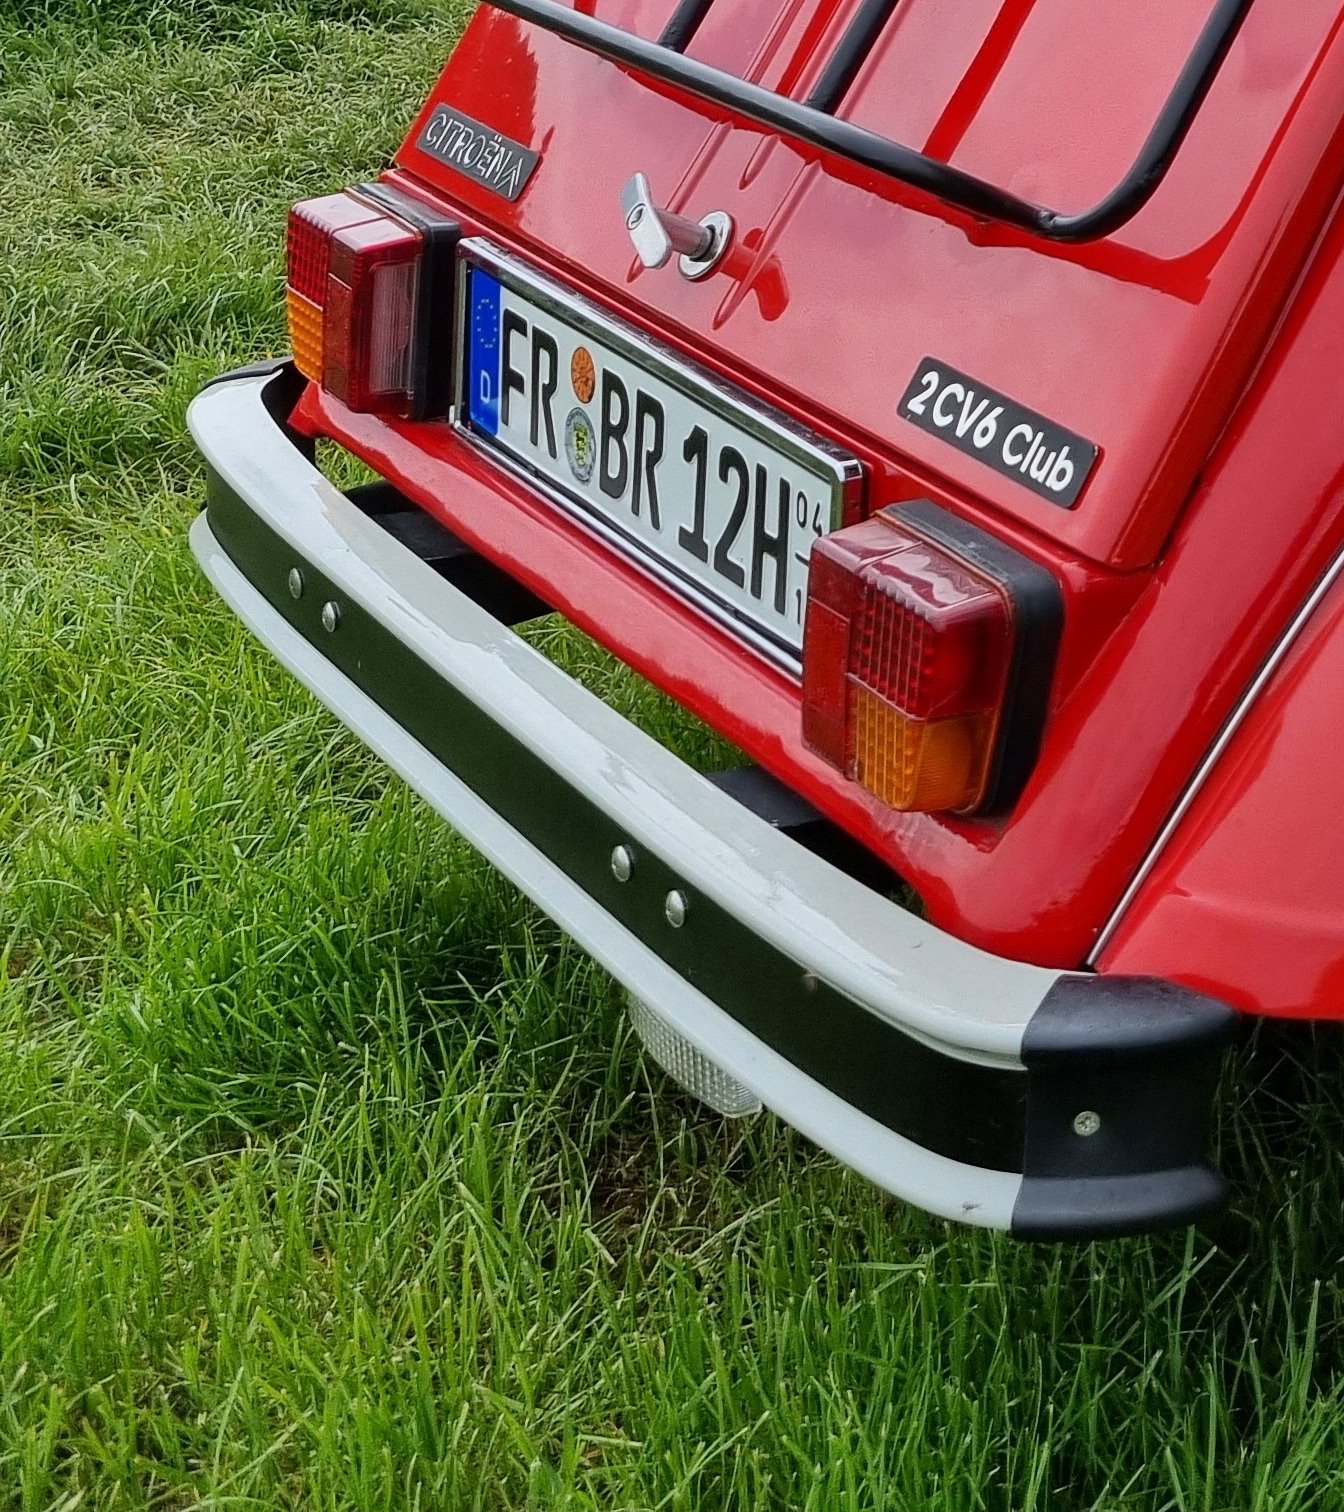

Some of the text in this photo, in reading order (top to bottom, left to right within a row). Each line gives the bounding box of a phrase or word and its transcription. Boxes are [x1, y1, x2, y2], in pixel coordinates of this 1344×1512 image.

[479, 369, 493, 405] D
[907, 371, 1074, 491] 2CV6 Club
[501, 310, 559, 460] FR
[602, 369, 665, 531] BR
[679, 426, 789, 616] 12H
